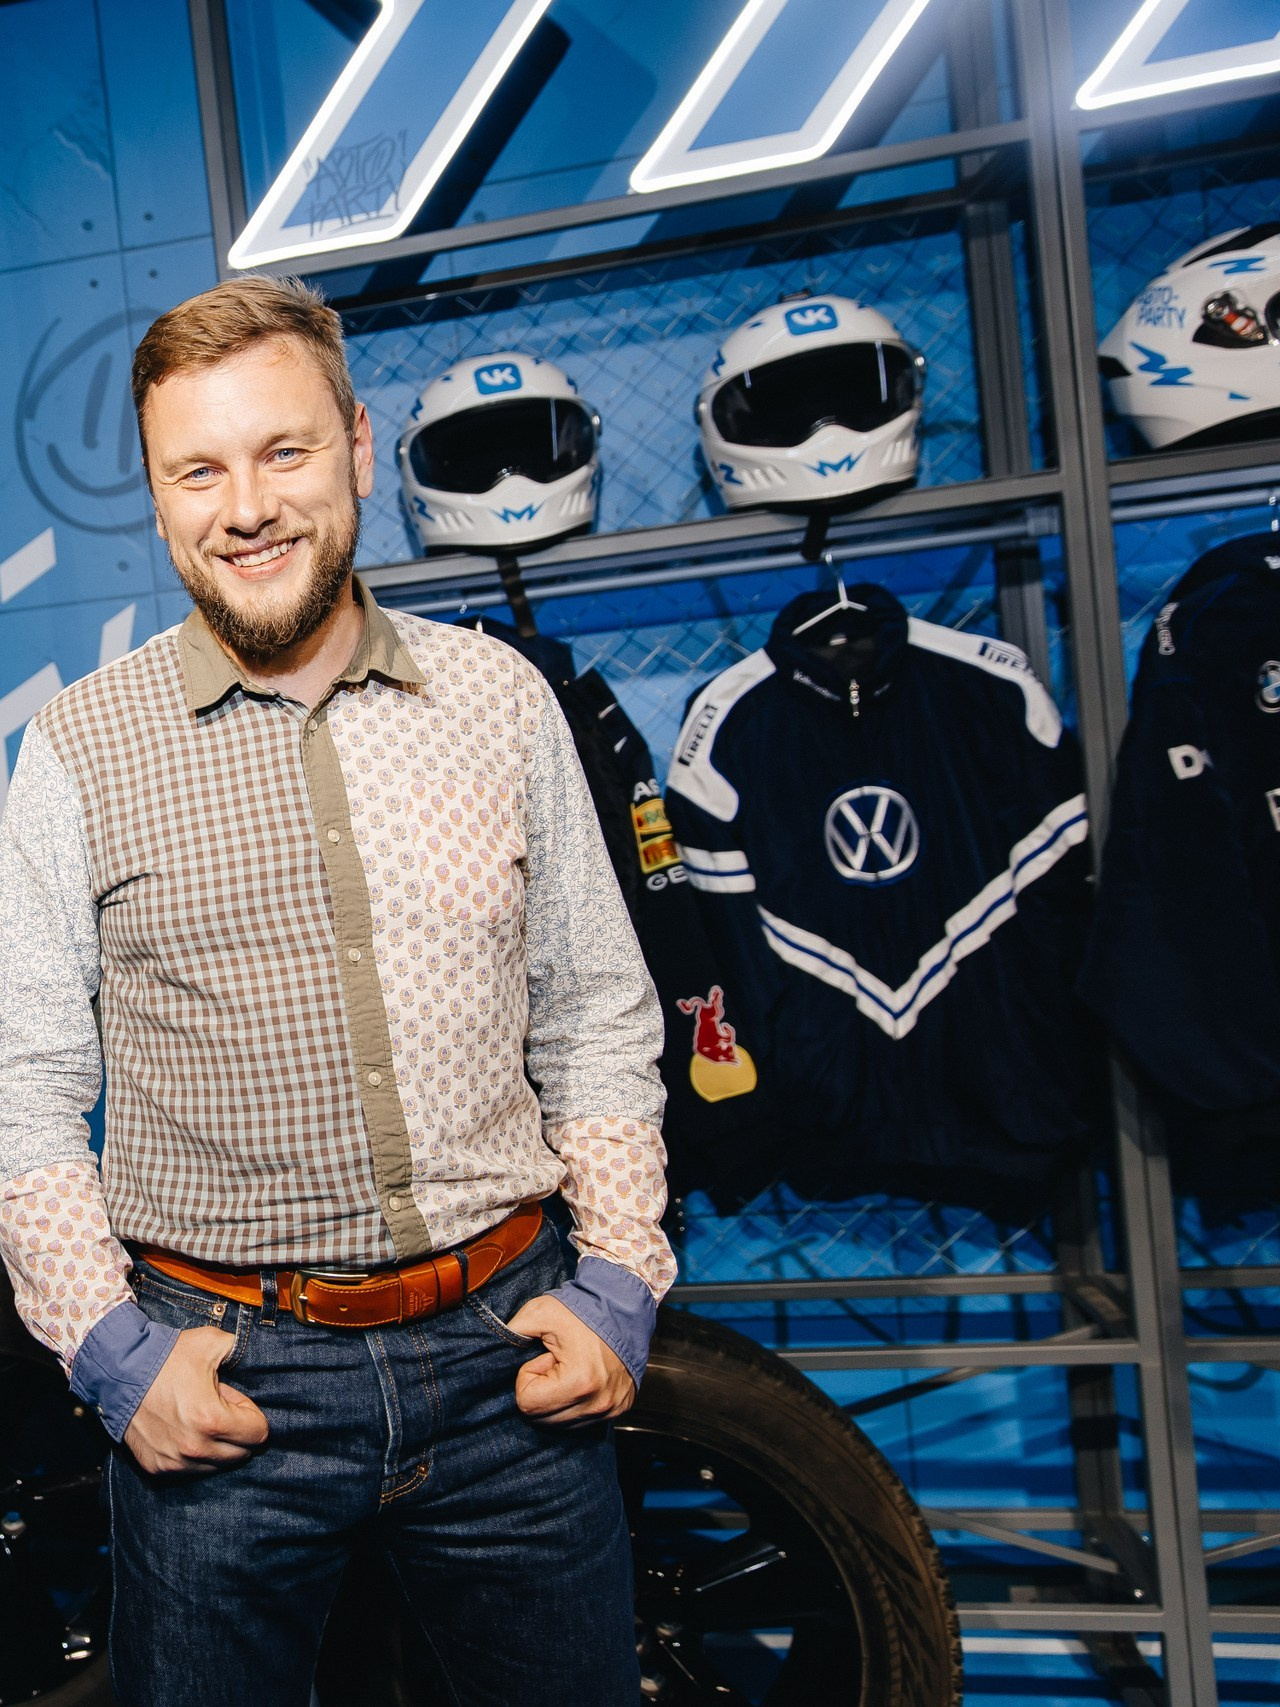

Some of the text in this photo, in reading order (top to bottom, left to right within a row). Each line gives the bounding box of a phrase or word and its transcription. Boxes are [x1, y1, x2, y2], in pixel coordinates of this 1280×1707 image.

[790, 307, 832, 326] VK
[1136, 305, 1186, 329] PARTY
[480, 366, 517, 386] VK
